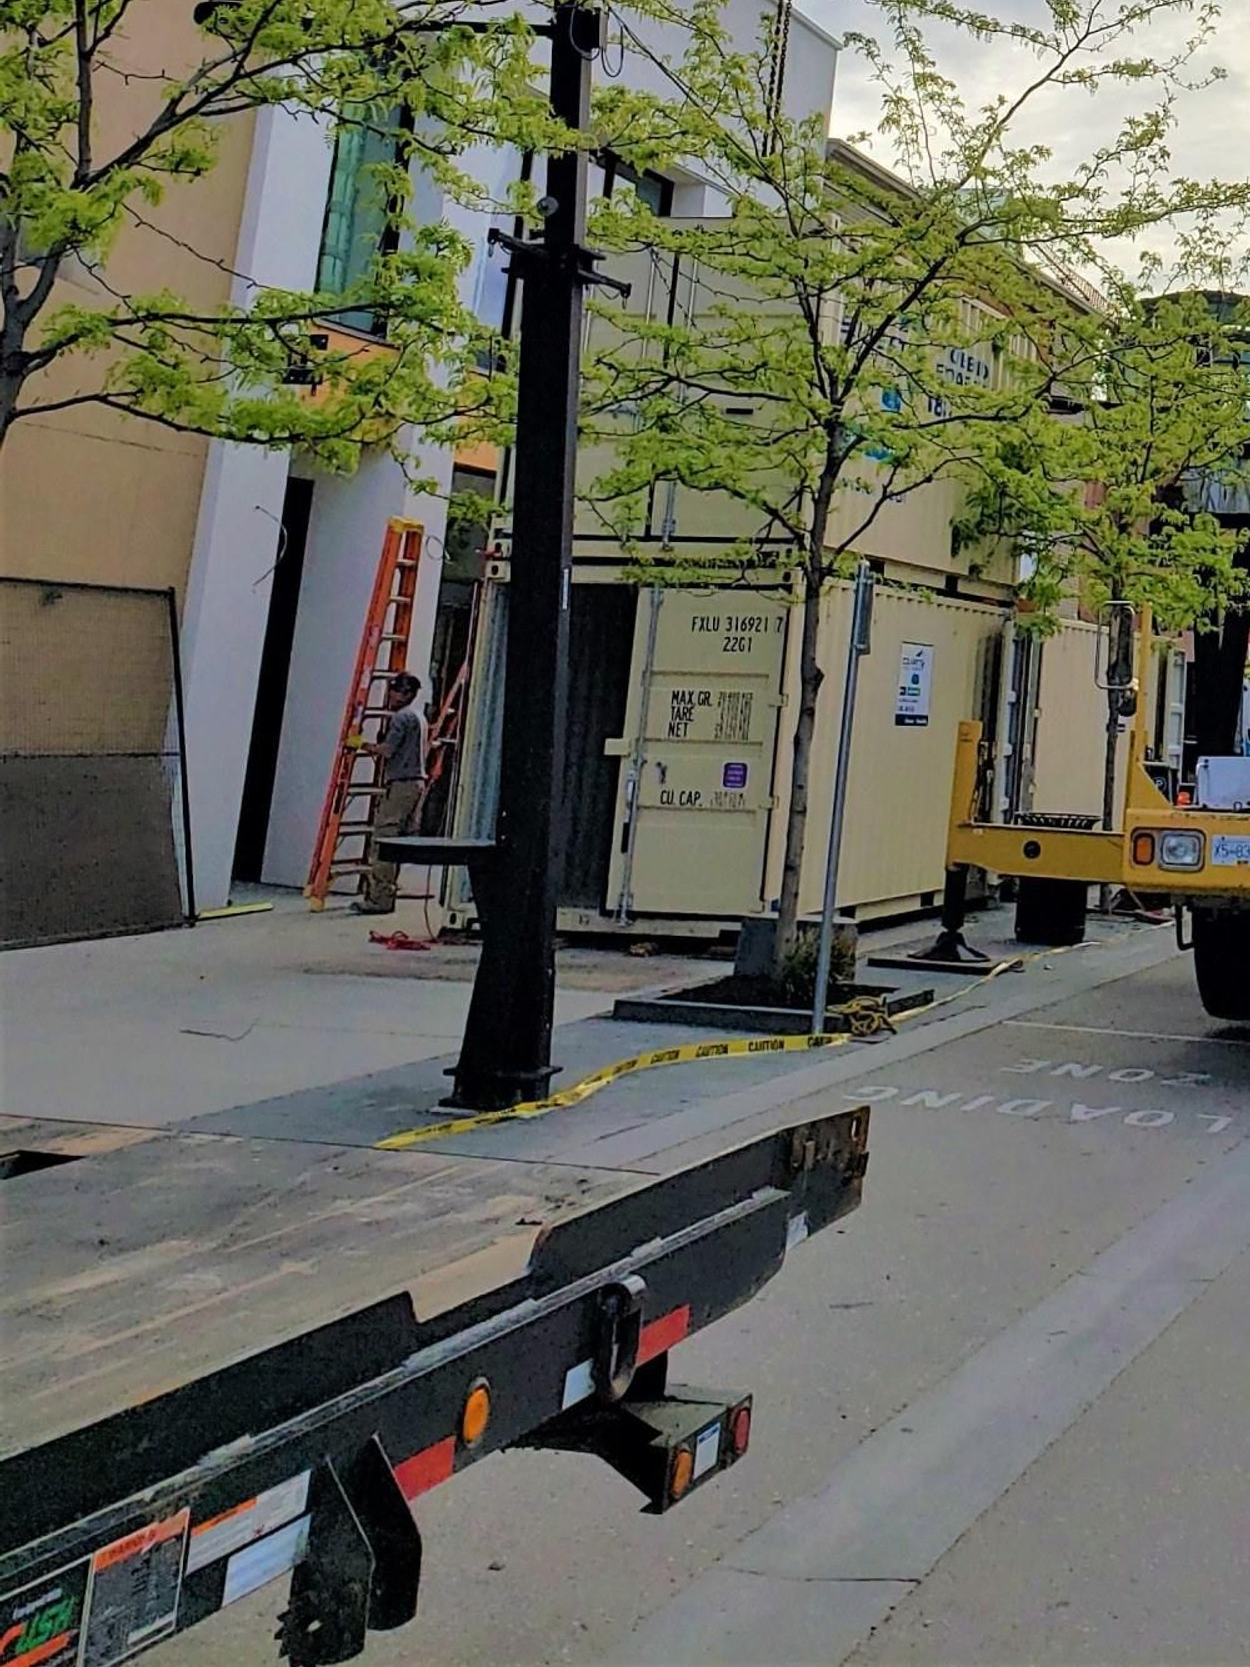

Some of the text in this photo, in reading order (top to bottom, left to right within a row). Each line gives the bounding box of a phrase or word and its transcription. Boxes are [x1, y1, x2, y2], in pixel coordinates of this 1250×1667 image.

[691, 615, 785, 633] FXLU 316921 7
[722, 636, 753, 653] 22G1
[671, 706, 695, 722] TARE
[668, 722, 689, 738] NET
[748, 1039, 785, 1052] CAUTION
[1001, 1058, 1212, 1087] ZONE
[842, 1085, 1232, 1133] LOADING
